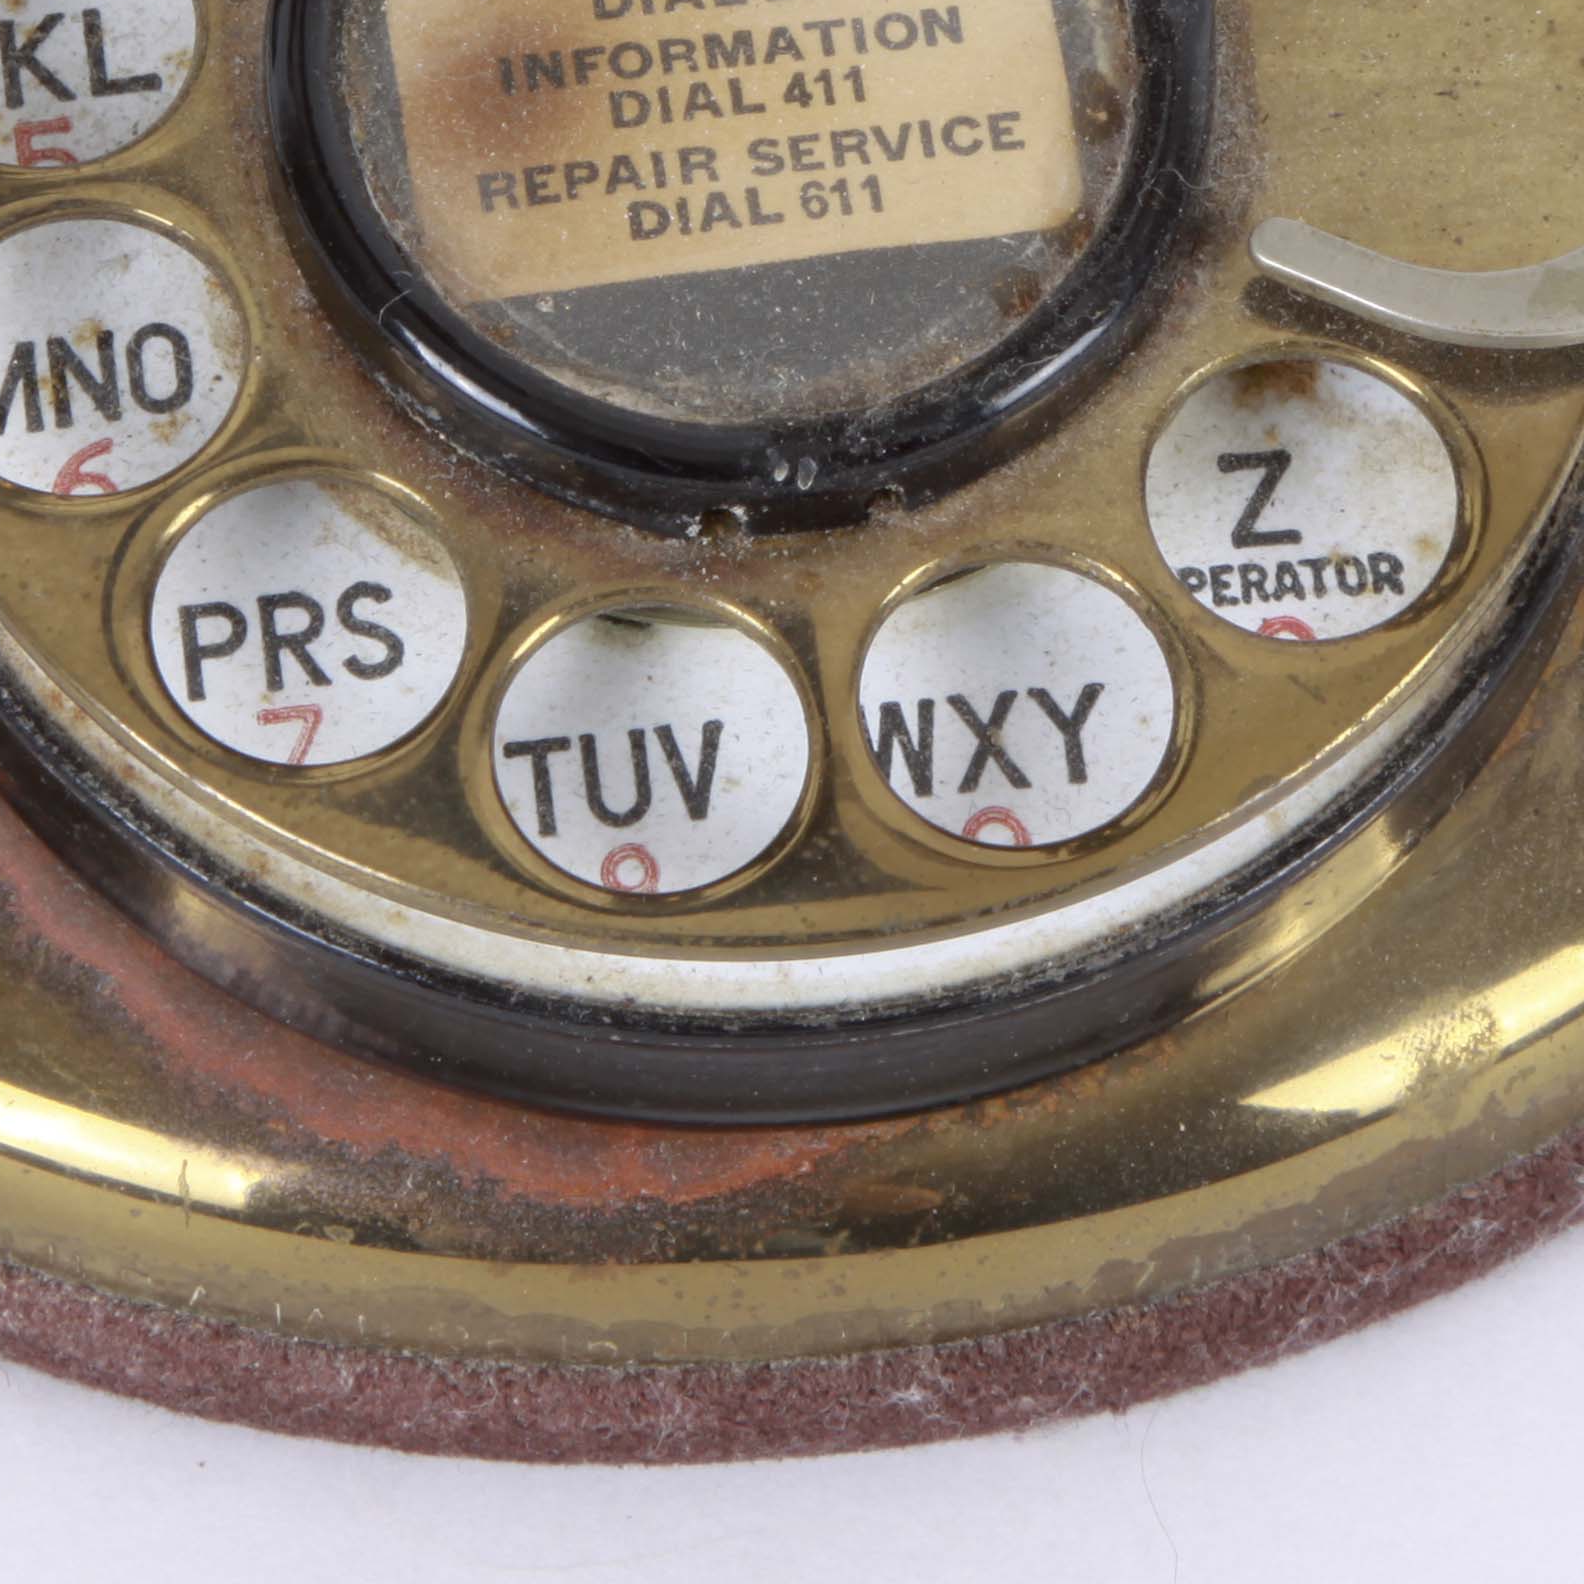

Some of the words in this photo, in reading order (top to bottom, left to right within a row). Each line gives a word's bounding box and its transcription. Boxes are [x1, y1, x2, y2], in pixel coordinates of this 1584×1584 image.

[498, 4, 964, 96] INFORMATION
[608, 76, 766, 129] DIAL
[783, 66, 868, 110] 411
[475, 145, 719, 213] REPAIR
[748, 112, 1026, 175] SERVICE
[628, 188, 783, 241] DIAL
[799, 174, 885, 219] 611
[51, 437, 120, 496] 6
[1217, 448, 1304, 550] Z
[1175, 551, 1406, 607] PERATOR
[178, 580, 405, 702] PRS
[257, 703, 324, 766] 7
[502, 718, 725, 837] TUV
[859, 681, 1105, 798] WXY
